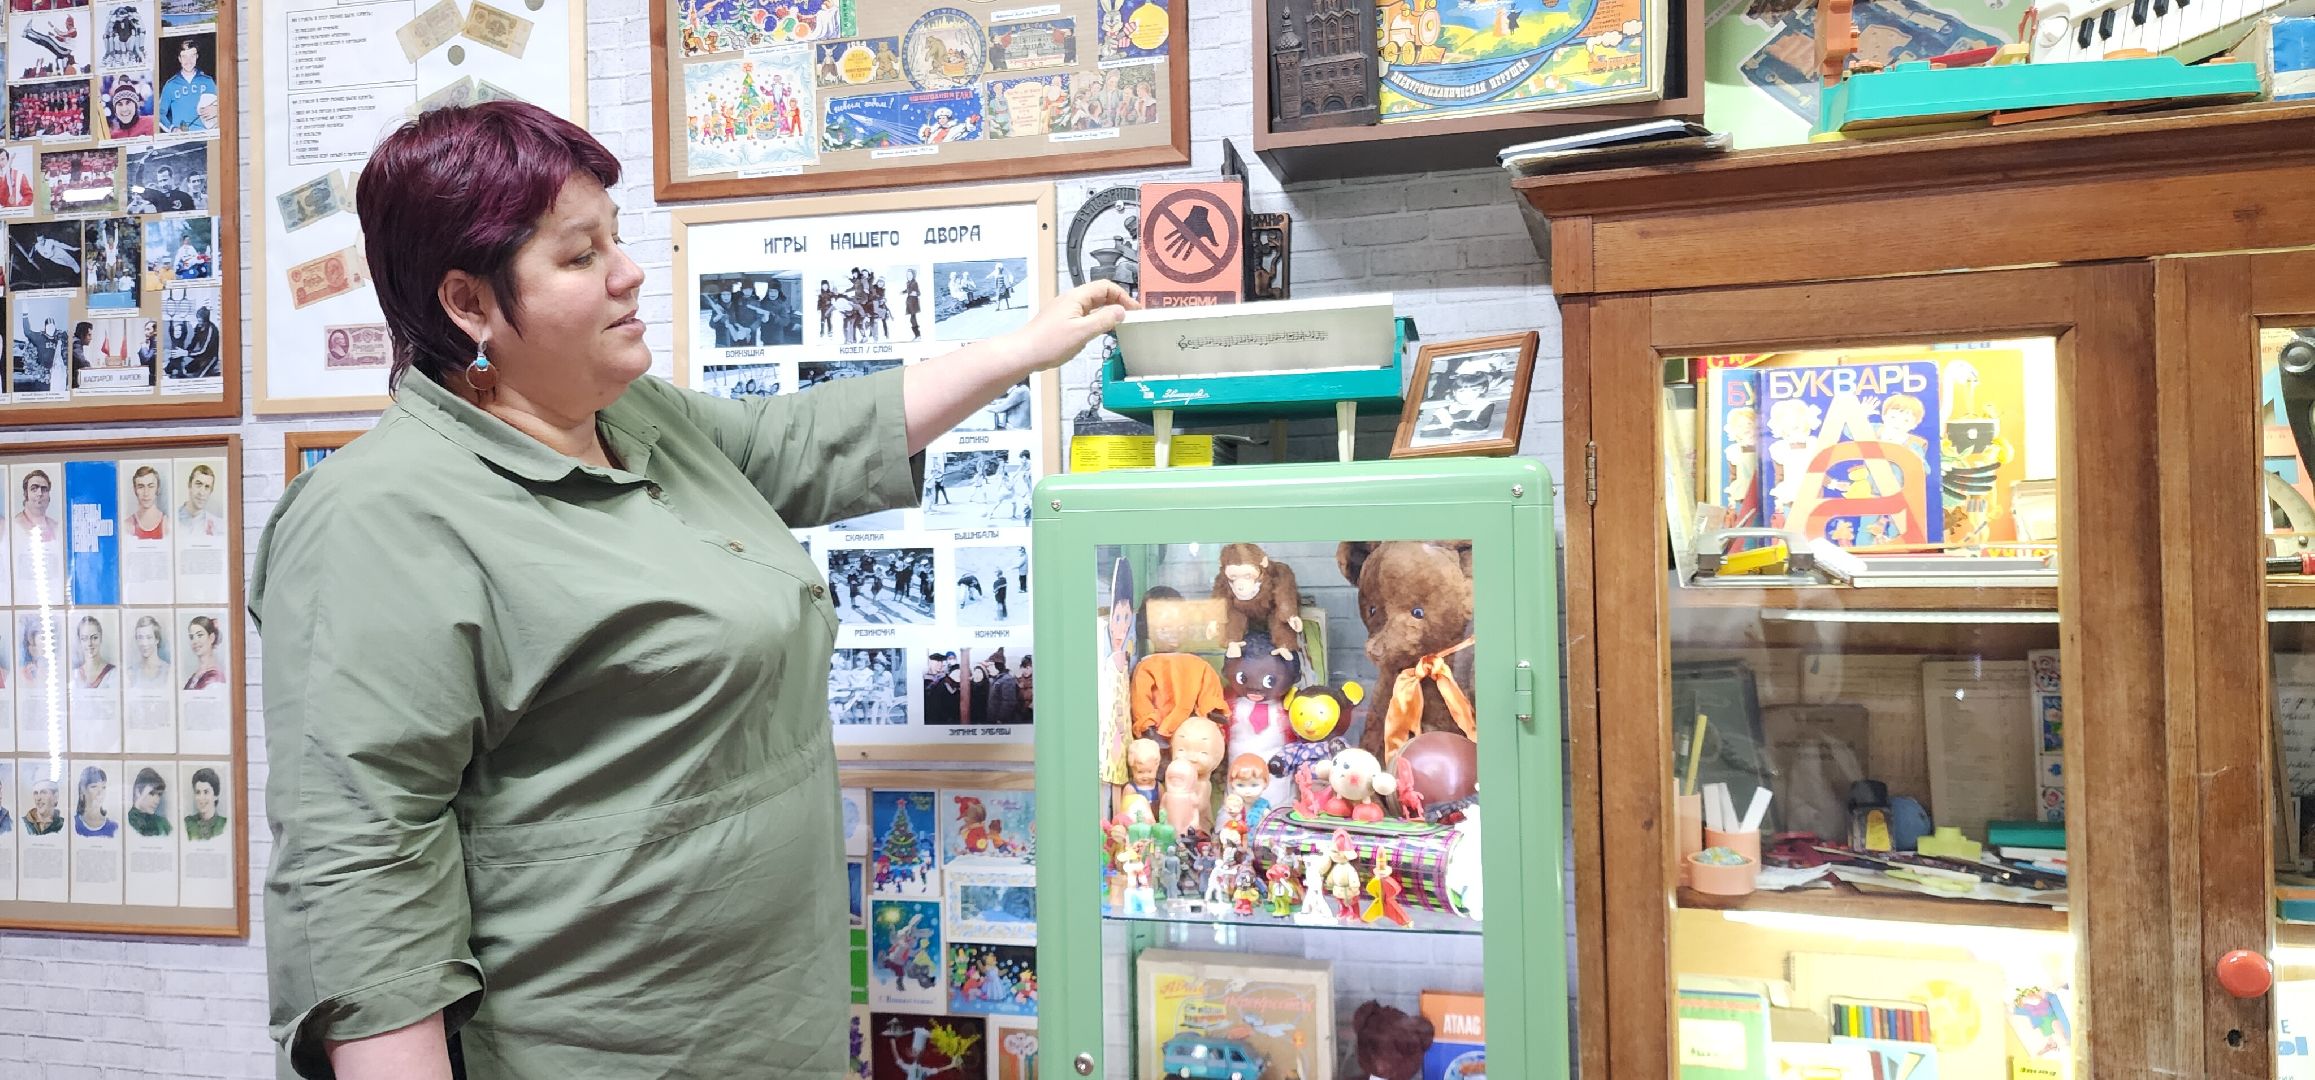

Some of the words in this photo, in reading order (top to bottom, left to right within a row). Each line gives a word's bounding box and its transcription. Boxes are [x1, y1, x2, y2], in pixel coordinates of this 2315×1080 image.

[1390, 71, 1487, 98] ЭЛЕКТРОМЕХАНИЧЕСКАЯ
[1489, 58, 1530, 90] ИГРУШКА
[174, 84, 207, 99] СССР
[764, 235, 807, 254] ИГРЫ
[831, 230, 900, 250] НАШЕГО
[924, 224, 981, 244] ДВОРА
[725, 349, 765, 358] ВОЙНУШКА
[839, 346, 864, 355] КОЗЕЛ
[872, 345, 893, 354] СЛОН
[1769, 365, 1928, 400] БУКВАРЬ
[959, 436, 989, 444] ДОМИНО
[845, 533, 884, 542] СКАКАЛКА
[954, 530, 999, 541] ВЫШИБАЛЫ
[854, 628, 896, 637] РЕЗИНОЧКА
[974, 630, 1010, 638] НОЖИЧКИ
[948, 728, 978, 736] ЗИМНИЕ
[980, 727, 1012, 736] ЗАБАВЫ
[1443, 1014, 1481, 1035] АТЛАС
